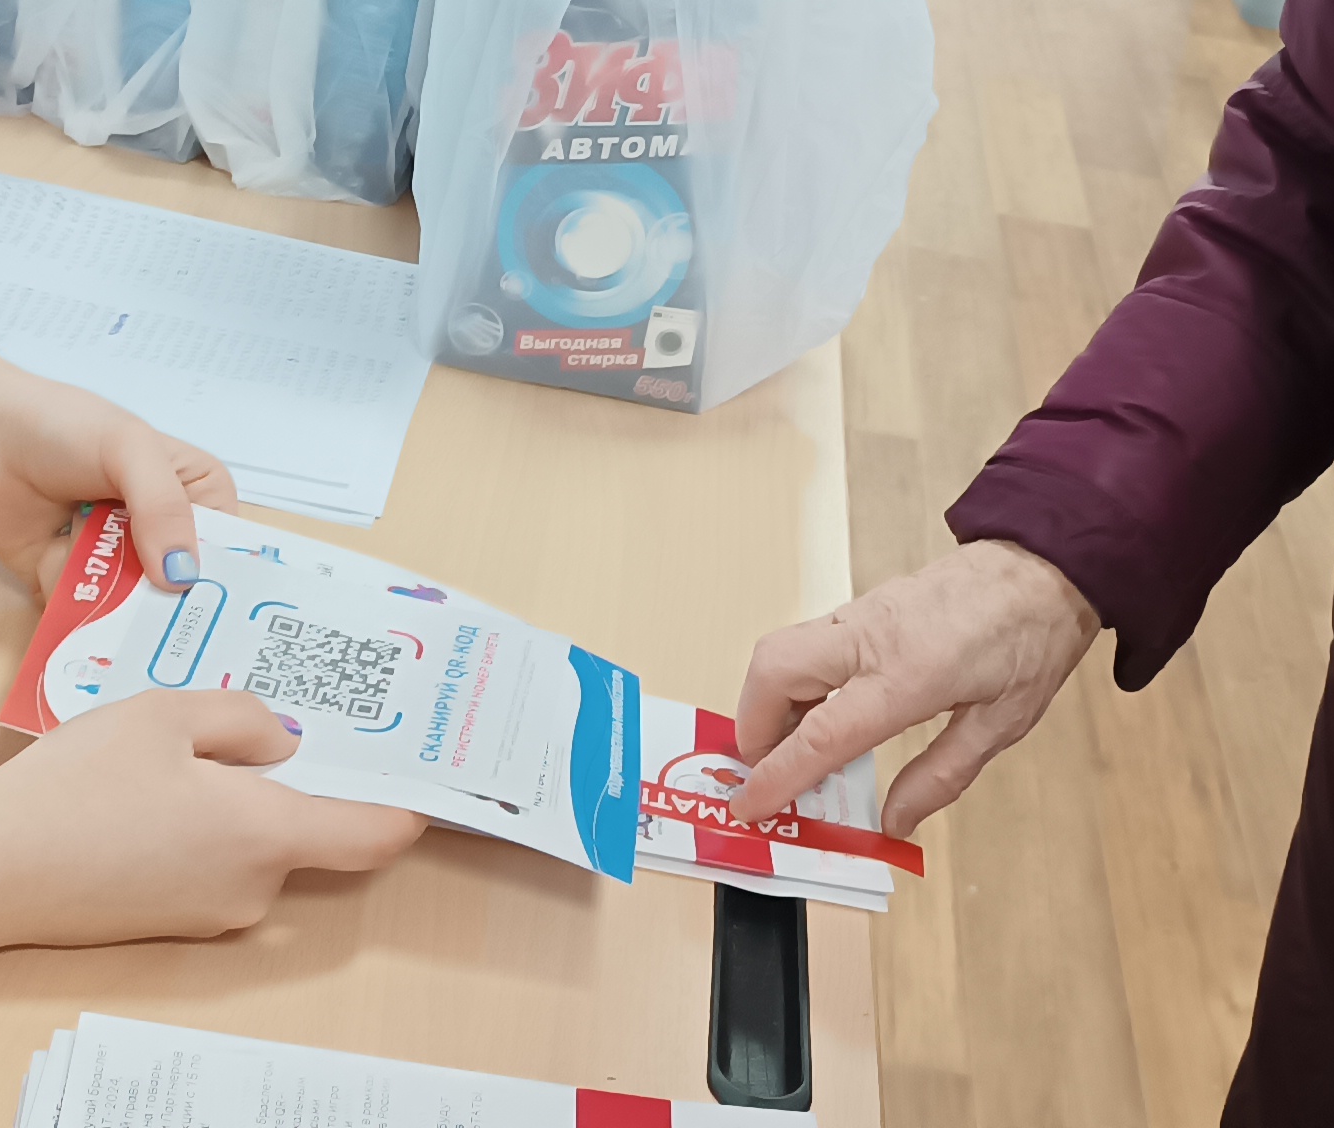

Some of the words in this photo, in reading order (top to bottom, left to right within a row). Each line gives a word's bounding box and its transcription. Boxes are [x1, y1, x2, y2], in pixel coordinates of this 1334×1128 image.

[519, 335, 623, 351] Выгодная
[567, 353, 638, 369] стирка
[72, 556, 110, 602] 15-17
[419, 681, 460, 762] СКАНИРУЙ
[444, 624, 482, 680] QR-КОД
[471, 665, 490, 699] НОМЕР
